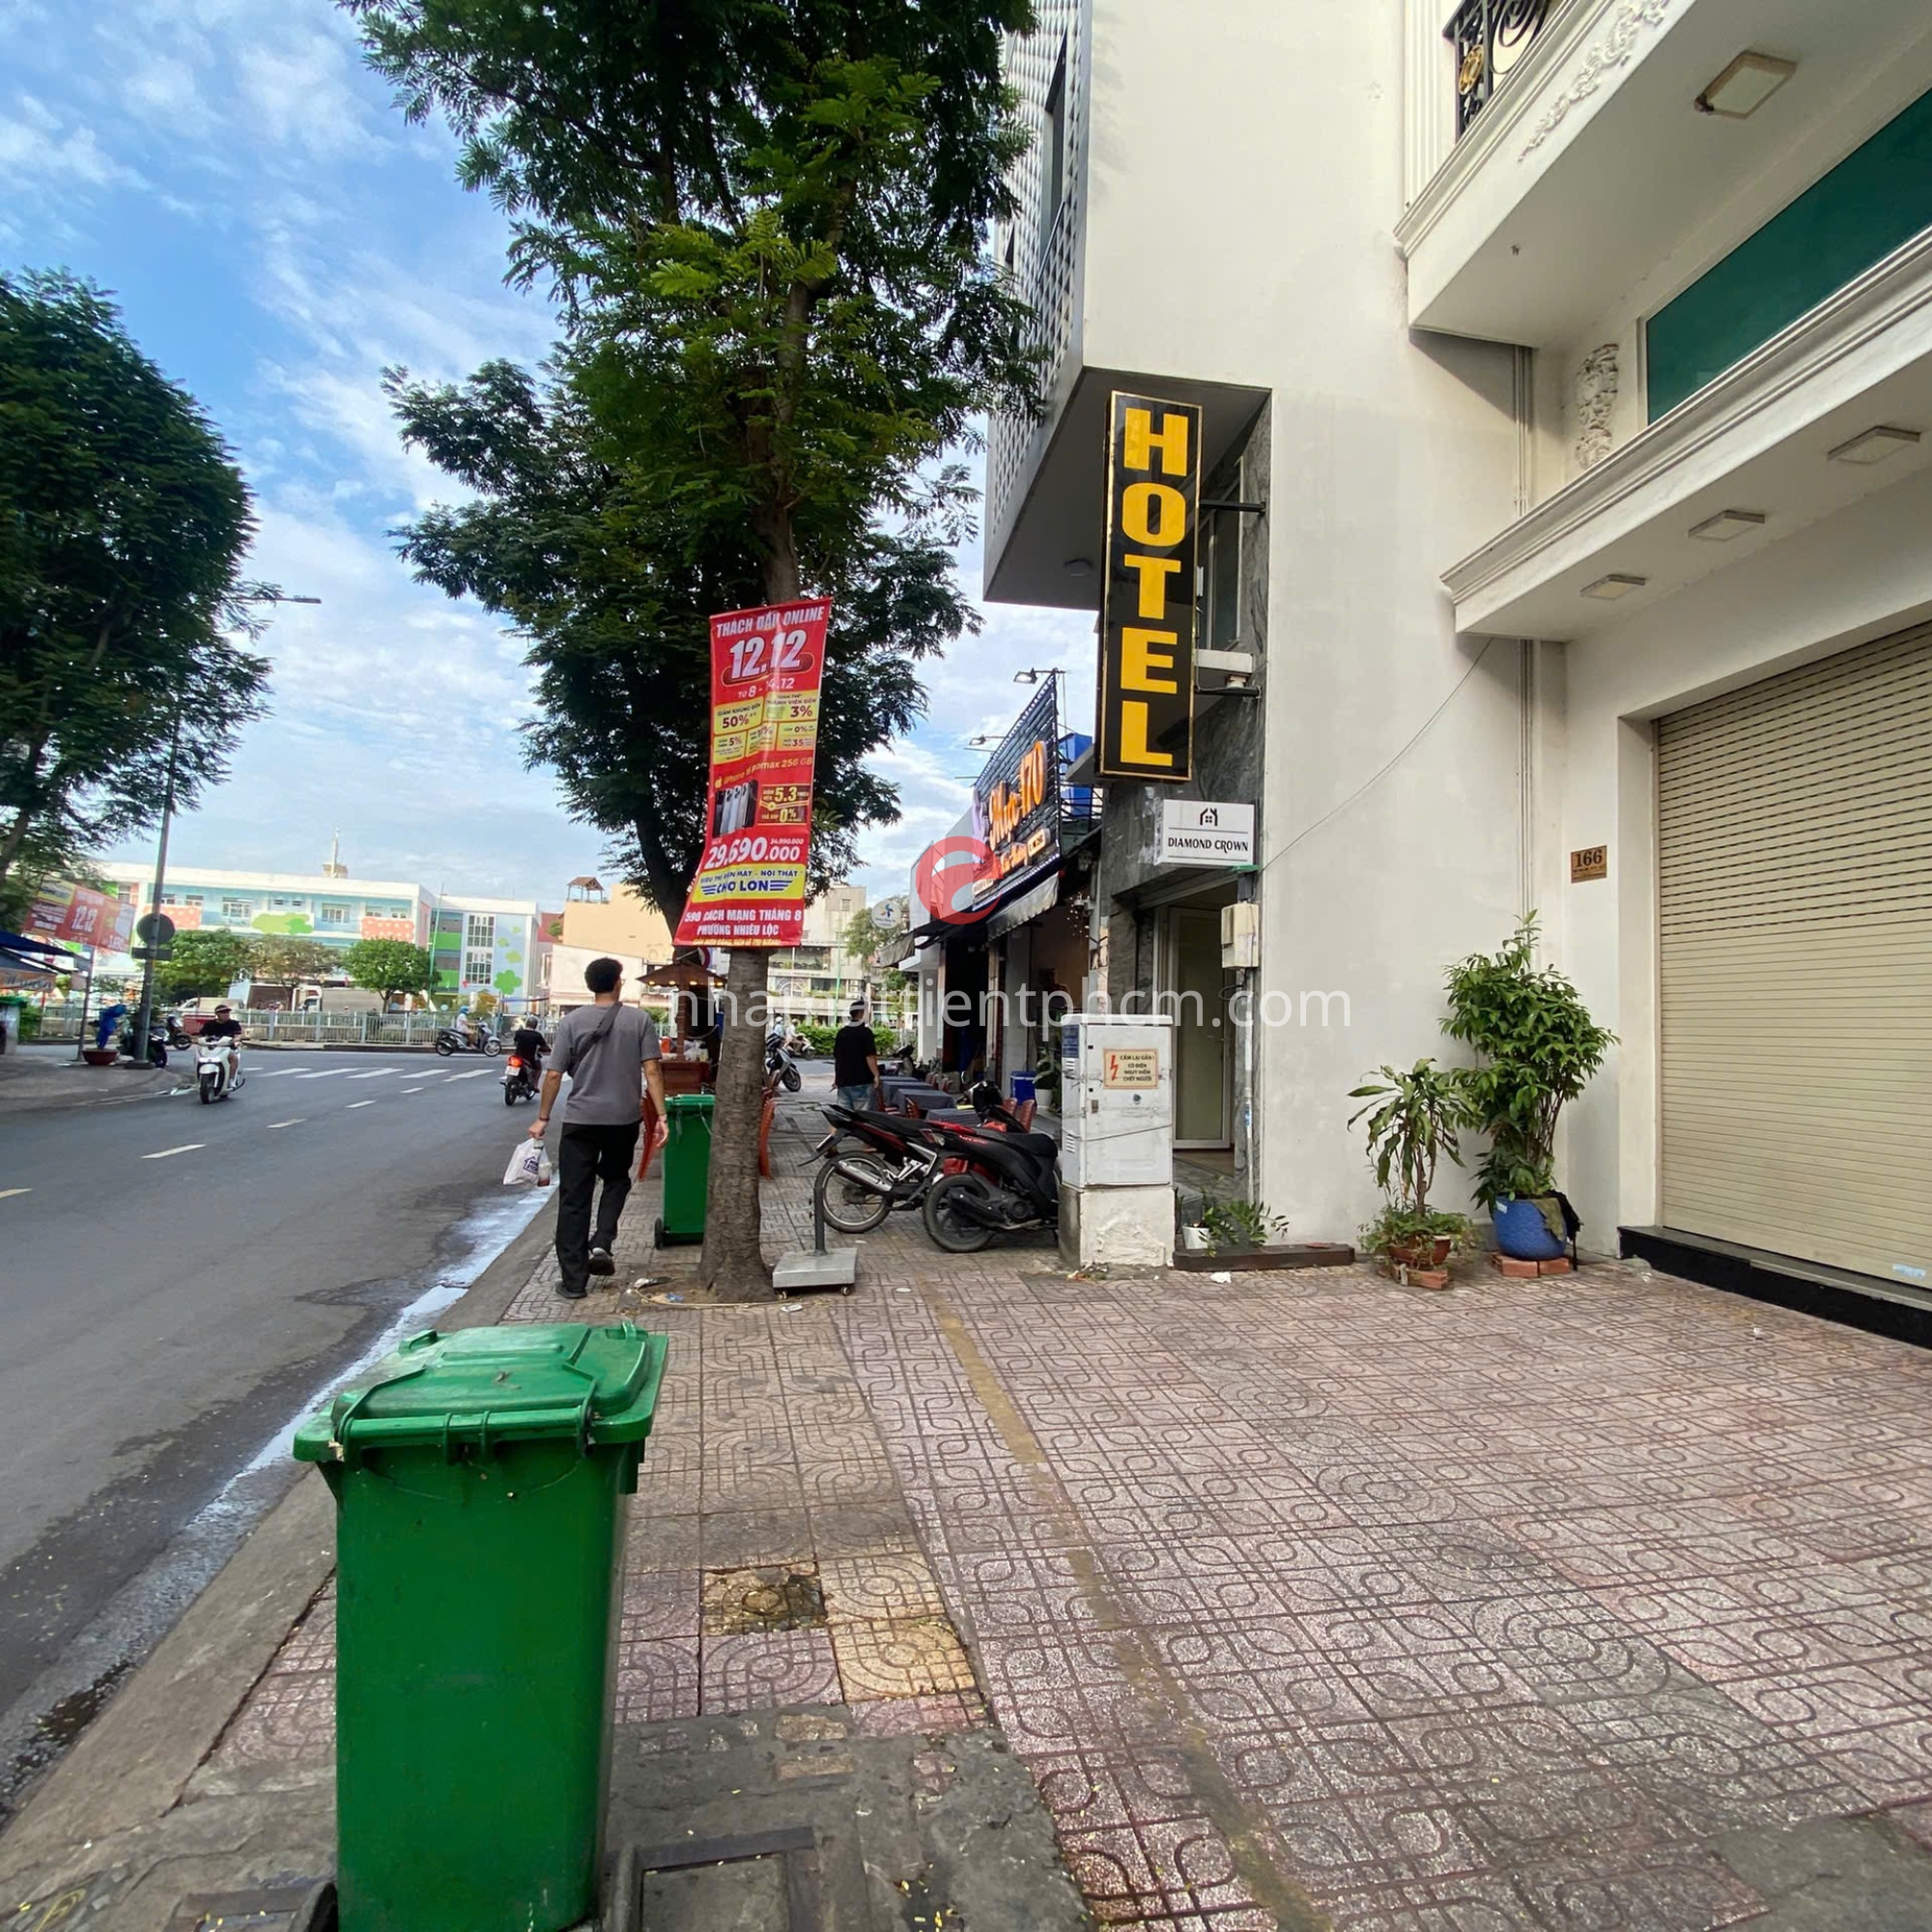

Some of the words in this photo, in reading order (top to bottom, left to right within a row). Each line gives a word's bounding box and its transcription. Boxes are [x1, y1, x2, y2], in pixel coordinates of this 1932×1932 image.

[1121, 407, 1189, 767] HOTEL
[783, 607, 825, 626] ONLINE
[729, 629, 808, 679] 12.12
[749, 685, 756, 697] 8
[789, 705, 813, 718] 3%
[781, 758, 799, 768] 256
[800, 756, 812, 765] GB
[775, 786, 798, 802] 5.3
[780, 808, 797, 822] 0%
[1167, 838, 1212, 849] DIAMOND
[1214, 839, 1249, 854] CROWN
[1575, 849, 1603, 868] 166
[684, 911, 701, 922] 590
[794, 910, 802, 922] 8
